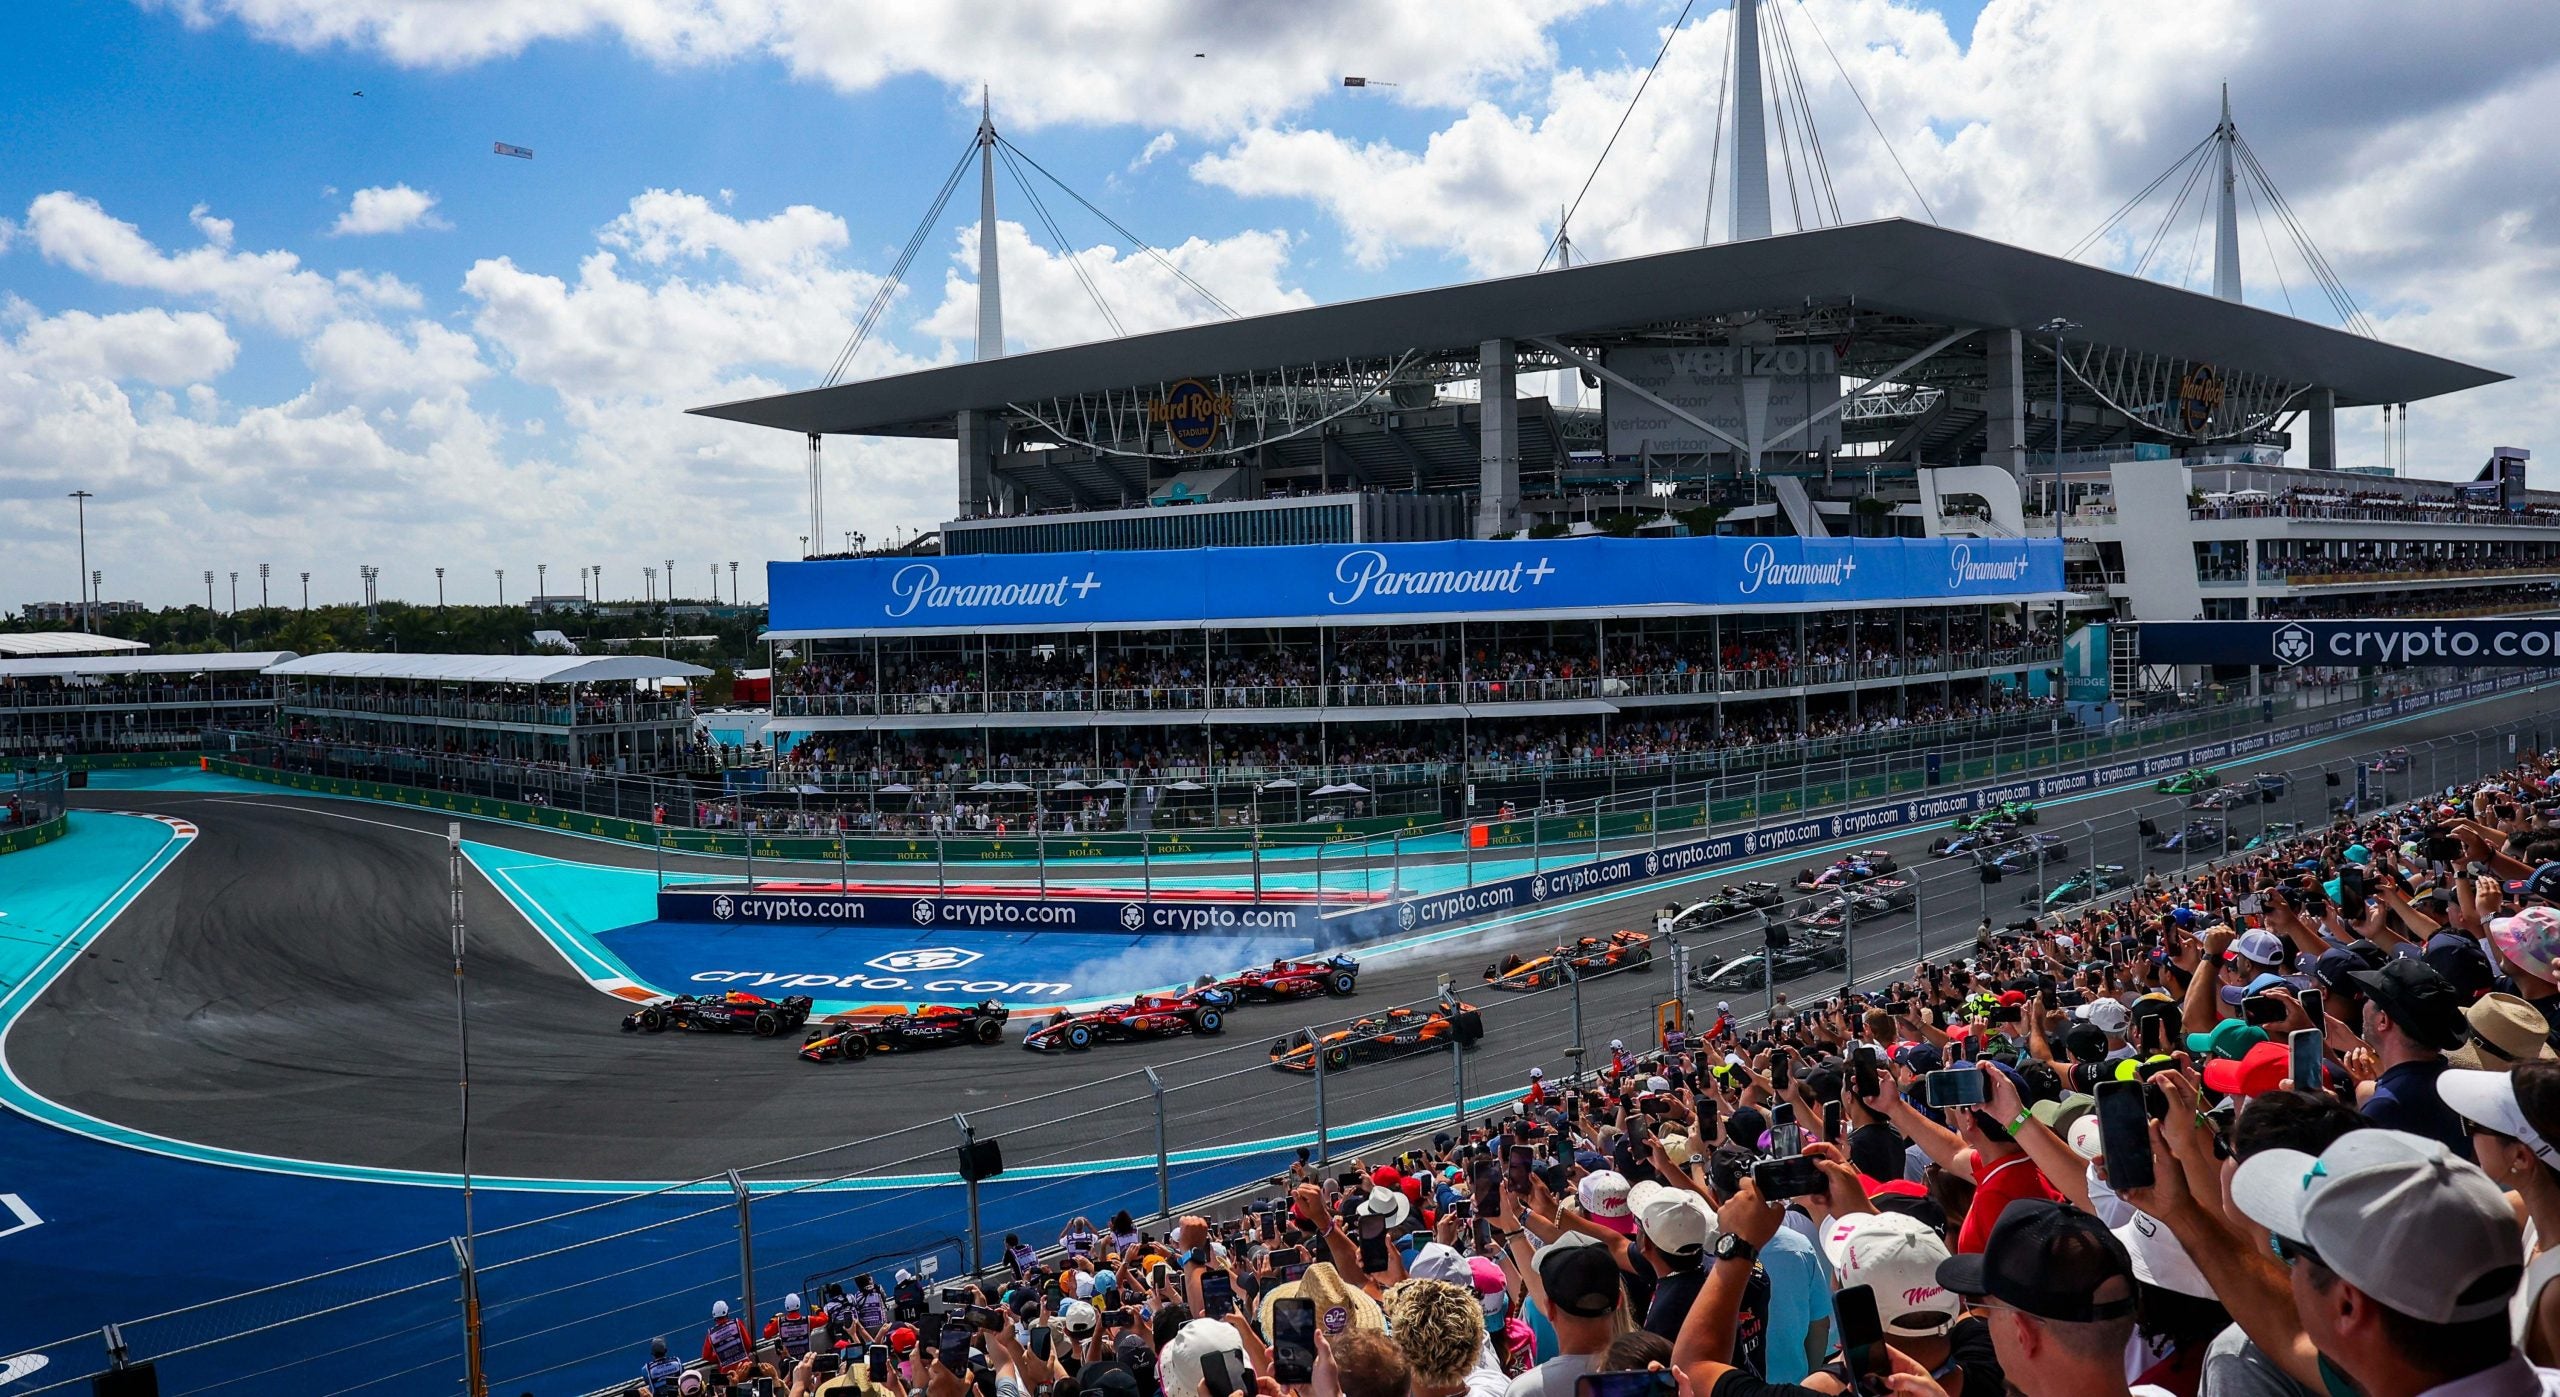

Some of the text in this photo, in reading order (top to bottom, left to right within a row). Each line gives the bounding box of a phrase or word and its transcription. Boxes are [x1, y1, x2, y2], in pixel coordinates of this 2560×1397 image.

[1667, 345, 1835, 376] verizon
[1150, 390, 1234, 422] Hard Rock
[1178, 427, 1209, 438] STADIUM
[1739, 543, 1857, 594] Paramount+
[1949, 543, 2029, 590] Paramount+
[1328, 550, 1556, 605] Paramount+
[885, 564, 1101, 618] Paramount+
[2066, 624, 2091, 677] 1
[2067, 677, 2106, 687] BRIDGE
[2151, 753, 2184, 772] crypto.com
[2195, 745, 2226, 763] crypto.com
[2047, 774, 2087, 794] crypto.com
[2101, 764, 2138, 783] crypto.com
[1986, 784, 2030, 806] crypto.com
[1919, 795, 1968, 817] crypto.com
[1844, 807, 1899, 832] crypto.com
[1244, 840, 1276, 849] RLEX
[1492, 834, 1522, 845] ROLEX
[1568, 830, 1596, 839] ROLEX
[1759, 823, 1821, 848] crypto.com
[757, 848, 781, 857] ROLEX
[897, 851, 928, 860] ROLEX
[981, 850, 1014, 859] ROLEX
[1068, 848, 1102, 857] ROLEX
[1158, 844, 1192, 853] ROLEX
[1662, 840, 1732, 869] crypto.com
[1551, 860, 1631, 893] crypto.com
[741, 898, 865, 920] crypto.com
[942, 902, 1076, 925] crypto.com
[1421, 886, 1514, 921] crypto.com
[1153, 906, 1297, 930] crypto.com
[690, 970, 1073, 995] crypto.com
[698, 1010, 731, 1021] ORACLE
[902, 1027, 943, 1036] ORACLE
[1902, 1285, 1945, 1306] Miam
[902, 1307, 916, 1320] 114
